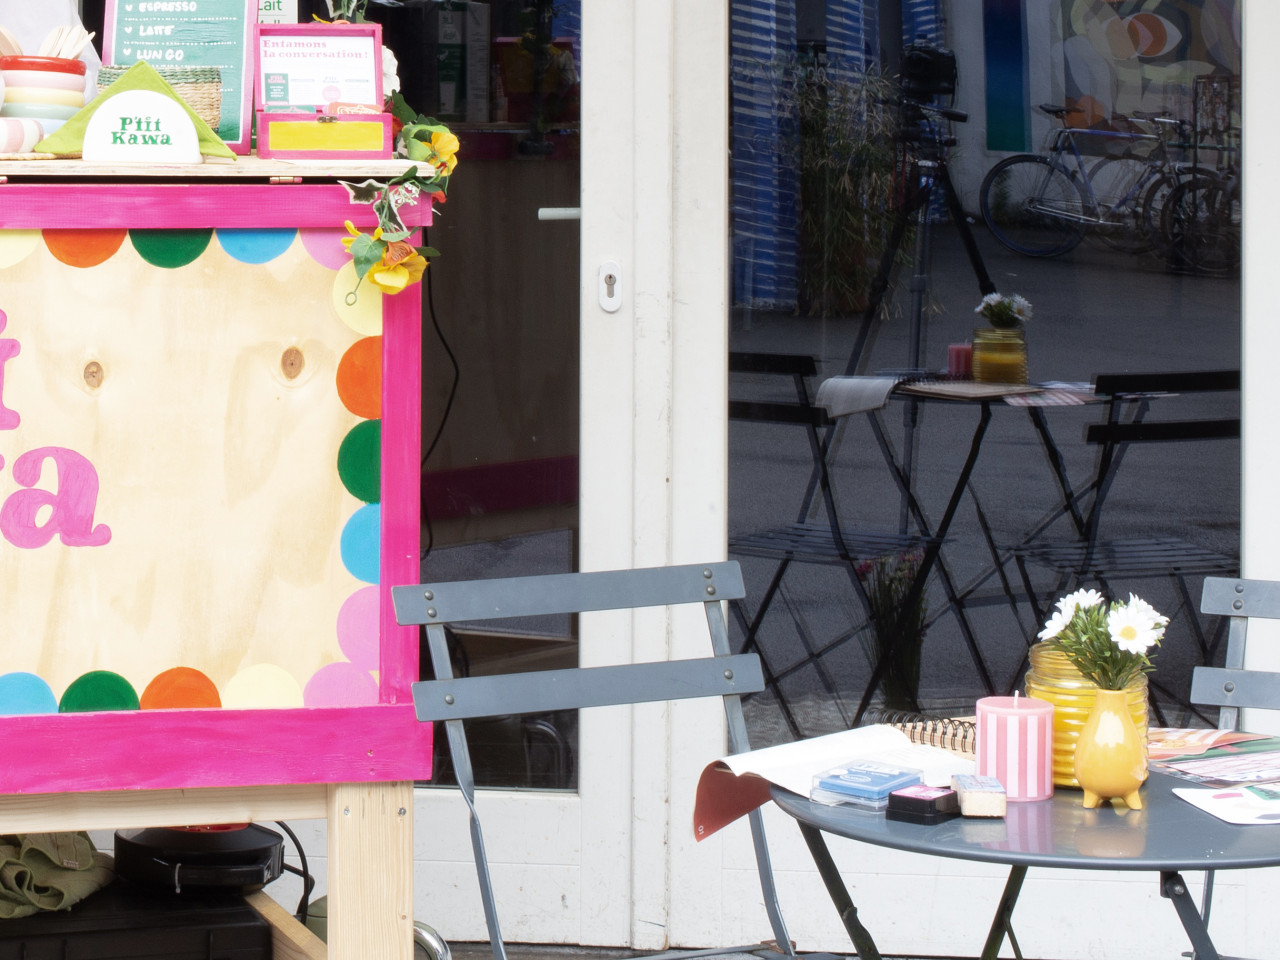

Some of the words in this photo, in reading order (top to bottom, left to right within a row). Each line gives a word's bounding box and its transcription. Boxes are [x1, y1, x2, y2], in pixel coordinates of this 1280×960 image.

[138, 1, 197, 12] ESPRESSO
[139, 25, 175, 36] LATTE
[262, 39, 327, 48] Entamons
[263, 50, 276, 58] la
[278, 50, 362, 59] conversation
[119, 116, 161, 132] P'tit
[111, 131, 173, 145] Kawa
